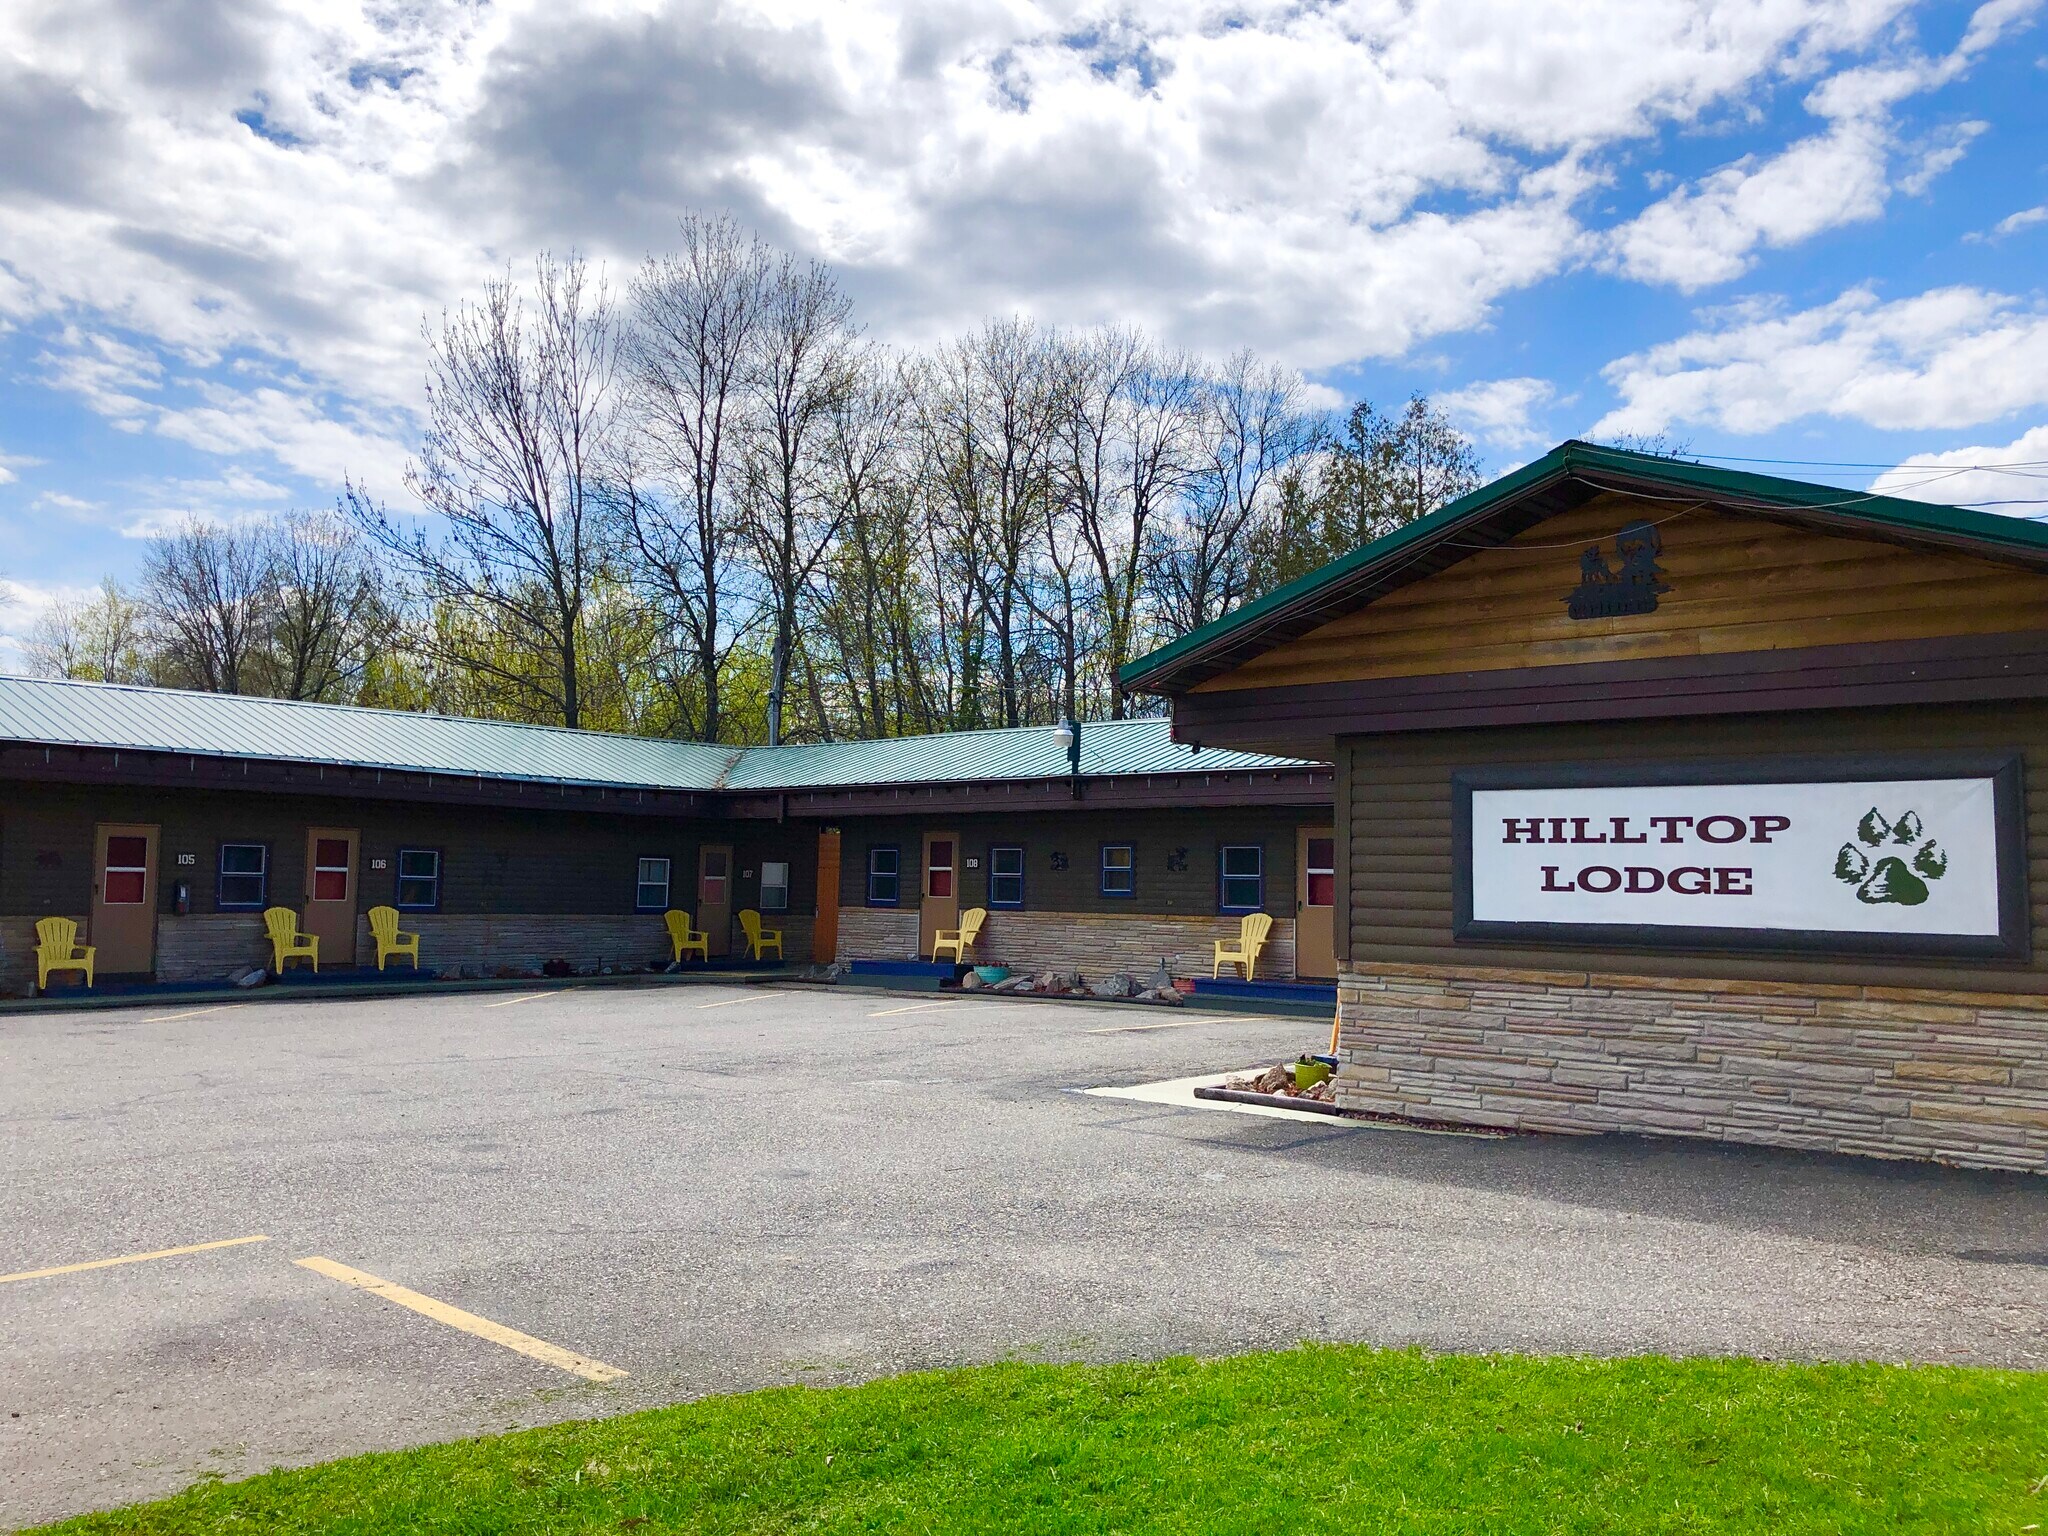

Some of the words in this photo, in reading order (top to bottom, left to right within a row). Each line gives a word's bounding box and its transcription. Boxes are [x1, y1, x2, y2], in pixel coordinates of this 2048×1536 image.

[1502, 815, 1791, 844] HILLTOP
[178, 854, 195, 865] 105
[371, 859, 387, 869] 106
[966, 858, 979, 868] 108
[742, 870, 753, 878] 107
[1540, 866, 1752, 895] LODGE
